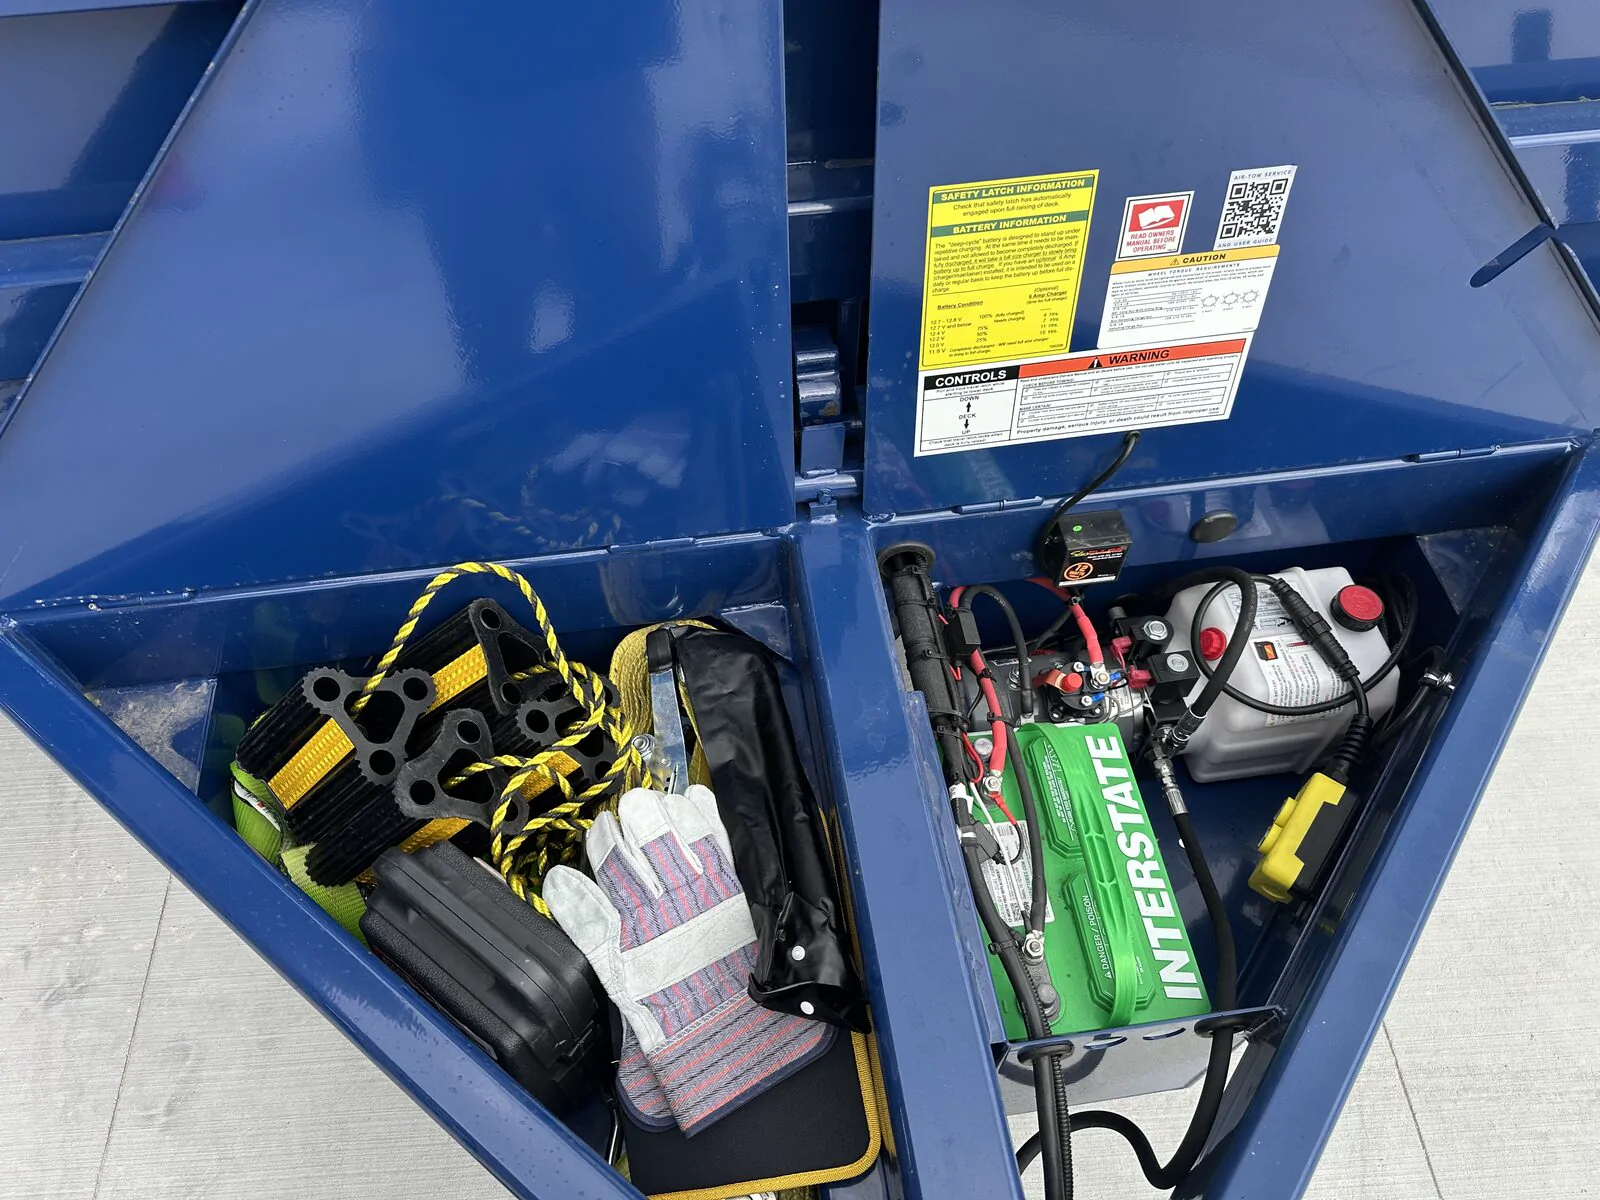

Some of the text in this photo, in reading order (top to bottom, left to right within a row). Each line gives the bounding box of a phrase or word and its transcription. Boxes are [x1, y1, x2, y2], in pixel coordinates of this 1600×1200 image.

[941, 178, 1084, 201] SAFETY LATCH INFORMATION
[986, 199, 1004, 207] safety
[1033, 192, 1071, 202] automatically
[962, 208, 988, 217] engaged
[1016, 203, 1035, 211] raising
[952, 214, 1066, 234] BATTERY INFORMATION
[1149, 230, 1174, 238] OWNERS
[970, 250, 989, 258] allowed
[1017, 244, 1043, 252] completely
[1133, 244, 1166, 252] OPERATING
[1035, 255, 1055, 263] optional
[1182, 253, 1226, 264] CAUTION
[1195, 262, 1240, 271] REQUIREMENTS
[957, 300, 983, 308] Condition
[1108, 349, 1170, 364] WARNING
[935, 369, 1007, 387] CONTROLS
[1182, 407, 1208, 415] improper
[1084, 735, 1203, 999] INTERSTATE
[1083, 894, 1097, 925] POISON
[1094, 934, 1110, 969] DANGER
